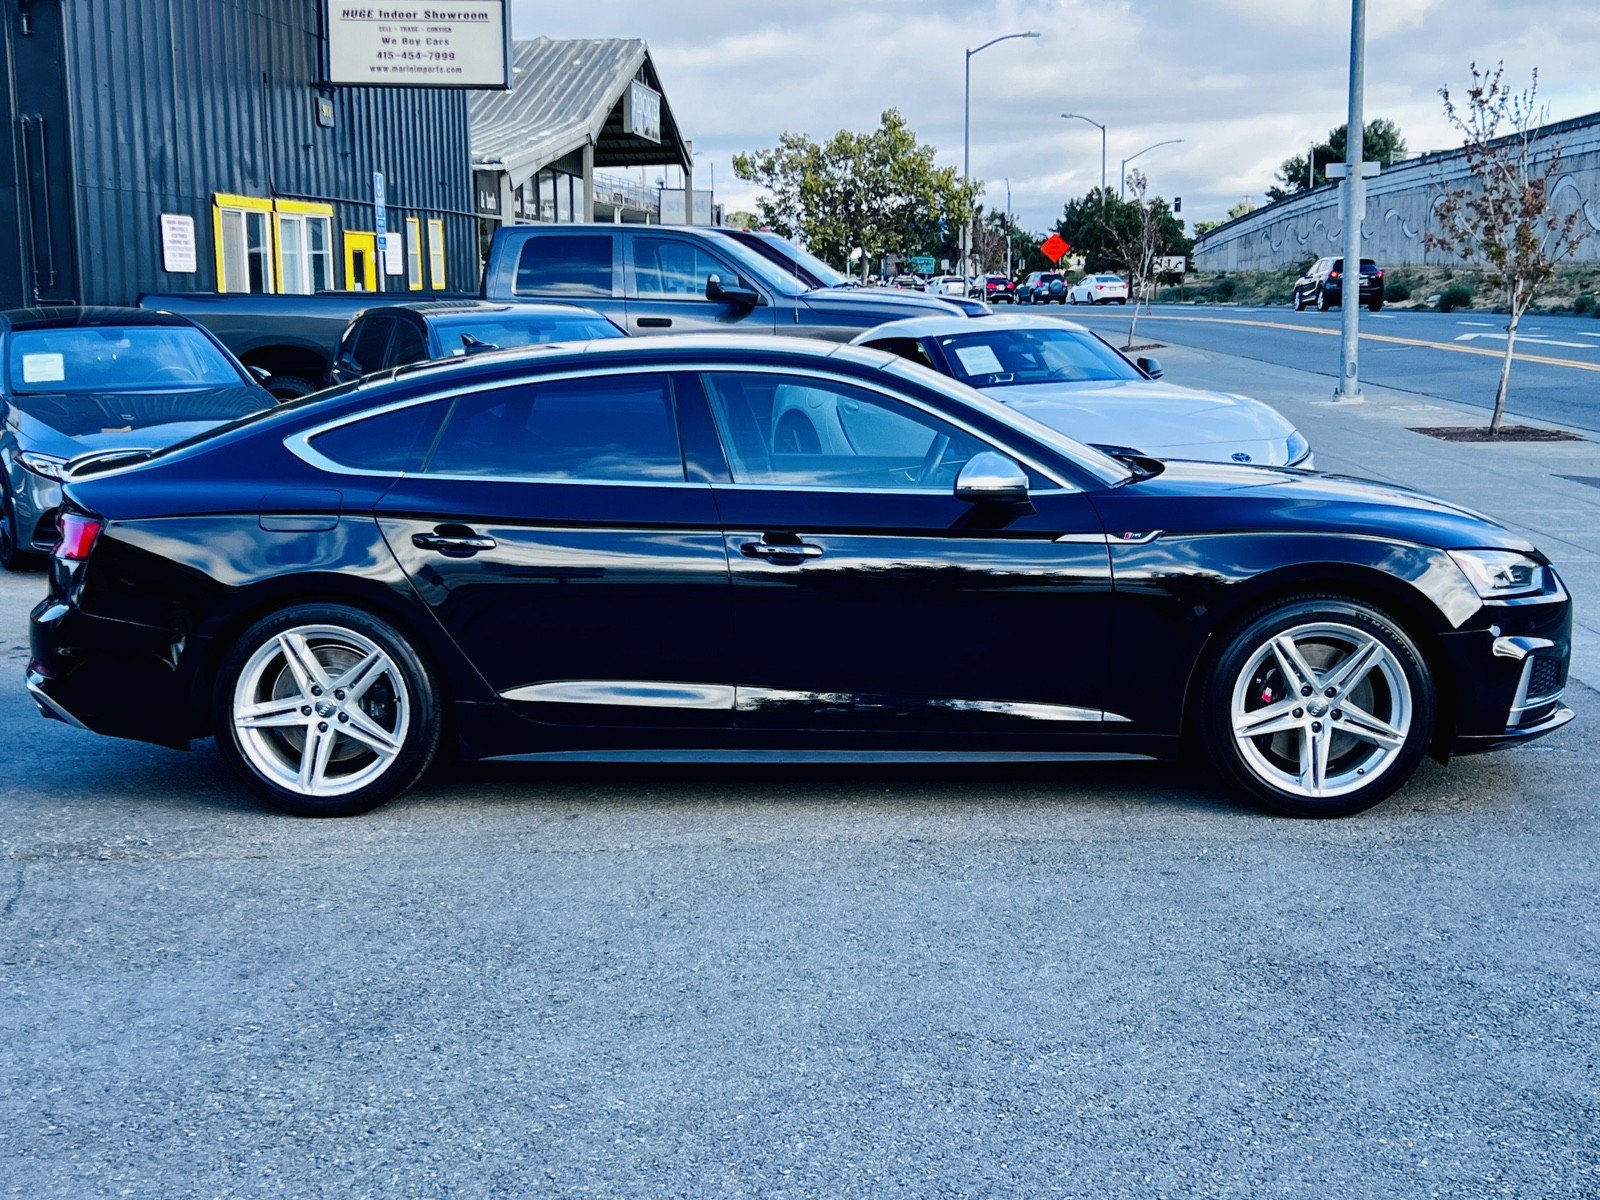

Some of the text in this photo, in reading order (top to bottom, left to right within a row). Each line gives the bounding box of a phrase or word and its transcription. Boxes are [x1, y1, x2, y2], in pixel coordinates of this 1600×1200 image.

[342, 9, 489, 20] HUGE Indoor Showroom
[381, 37, 450, 47] We Buy Cars
[376, 51, 456, 61] 415-454-7999
[369, 64, 463, 74] www.marinimports.com
